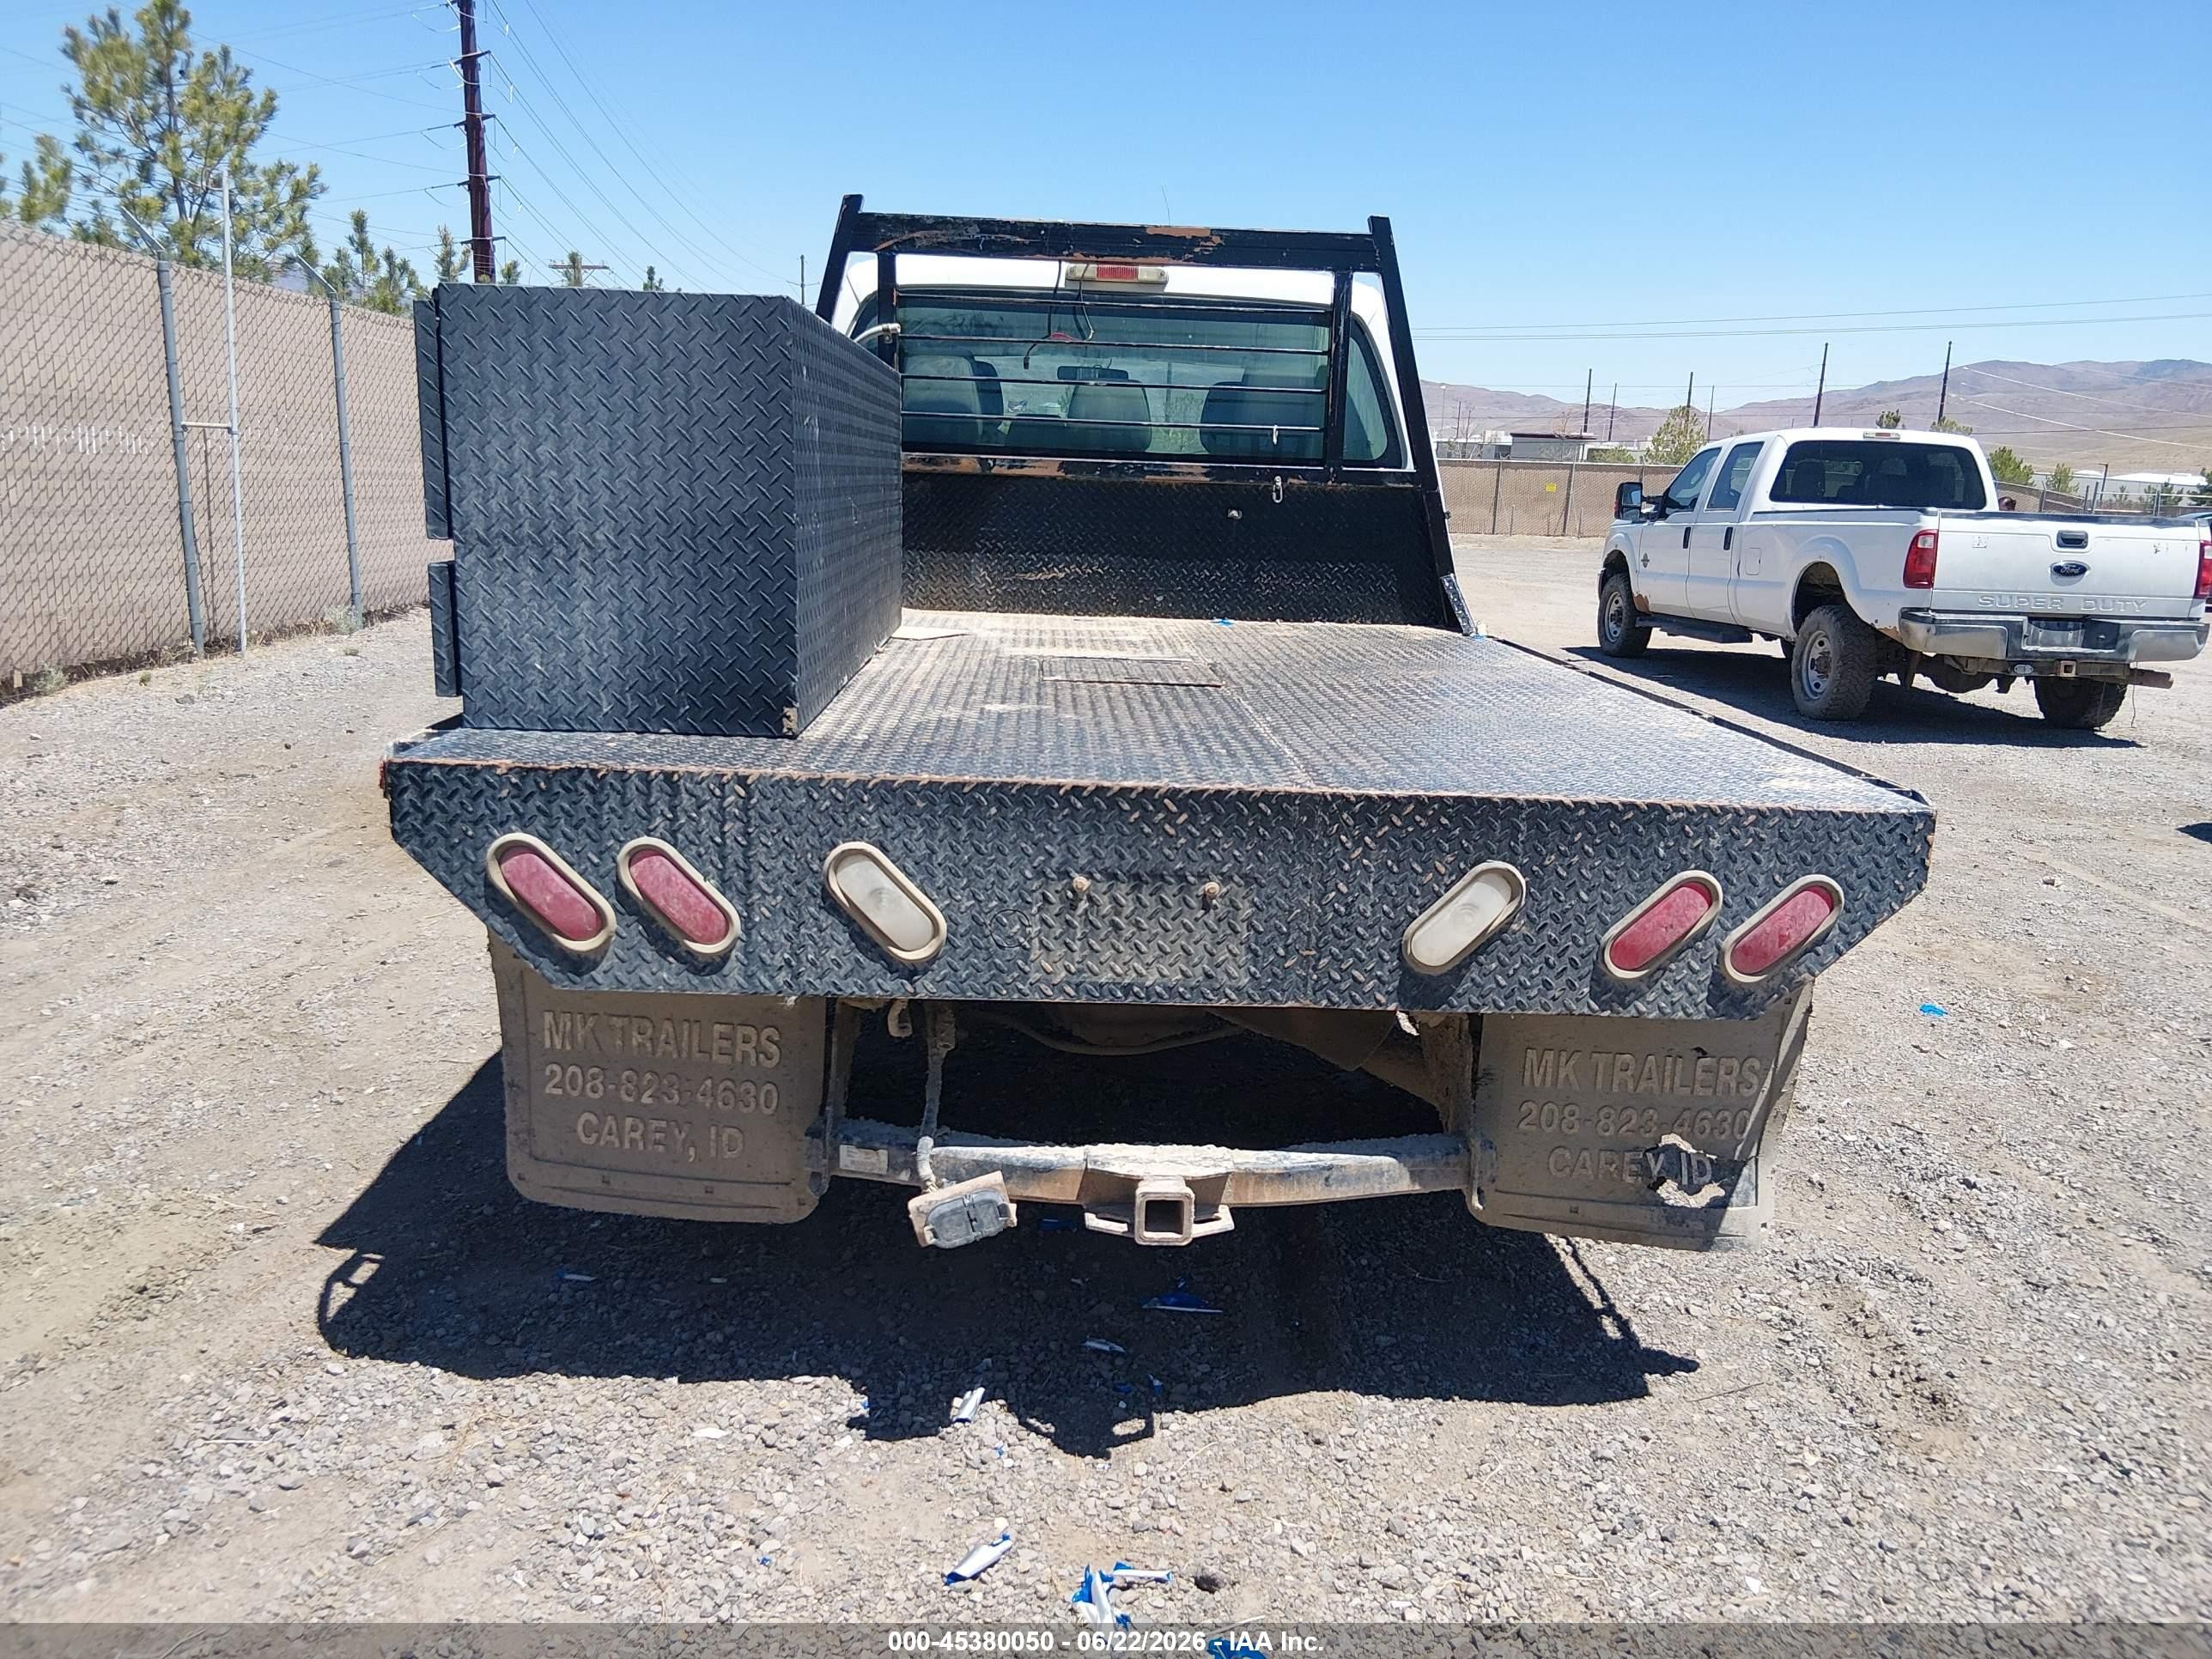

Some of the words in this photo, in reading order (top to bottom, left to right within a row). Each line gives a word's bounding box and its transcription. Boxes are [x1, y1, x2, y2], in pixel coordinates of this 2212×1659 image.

[2058, 562, 2082, 574] Ford
[1978, 595, 2063, 611] SUPER
[2081, 599, 2148, 612] DUTY
[543, 1011, 599, 1051] MK
[605, 1016, 782, 1069] TRAILERS
[543, 1062, 780, 1115] 208-823-4630
[1522, 1048, 1582, 1091] MK
[1589, 1052, 1761, 1097] TRAILERS
[576, 1111, 697, 1163] CAREY,
[709, 1125, 745, 1159] ID
[1517, 1100, 1752, 1140] 208-823-4630
[1680, 1152, 1714, 1187] ID
